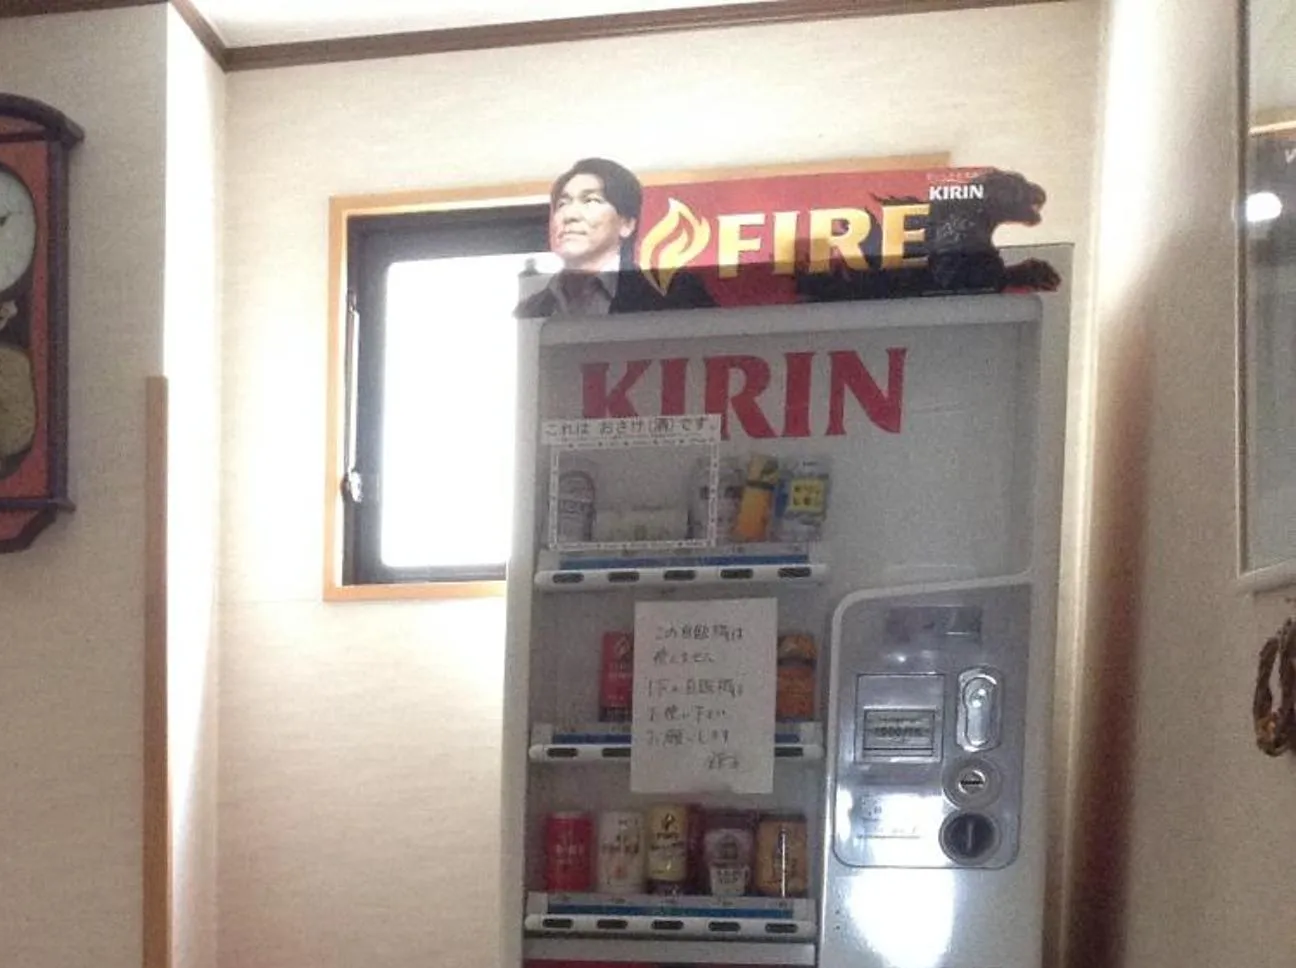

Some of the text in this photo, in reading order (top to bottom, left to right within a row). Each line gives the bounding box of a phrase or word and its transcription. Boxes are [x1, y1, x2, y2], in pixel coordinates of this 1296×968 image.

[929, 184, 984, 200] KIRIN
[716, 203, 932, 279] FIRE
[580, 346, 907, 441] KIRIN
